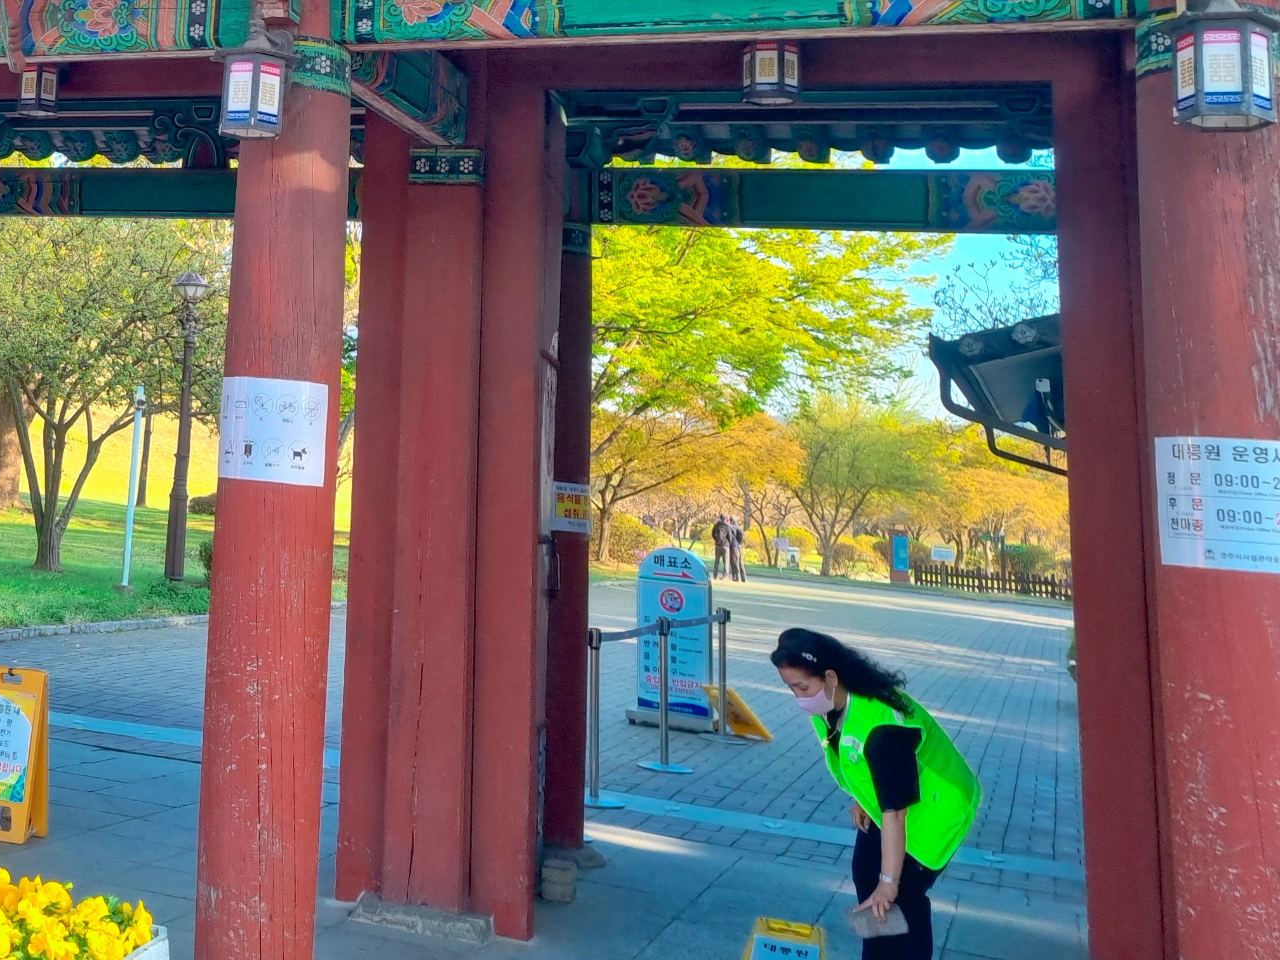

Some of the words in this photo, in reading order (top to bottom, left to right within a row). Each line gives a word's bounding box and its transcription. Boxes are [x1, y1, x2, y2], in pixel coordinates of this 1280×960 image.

[1172, 444, 1221, 461] 대릉원
[1171, 518, 1203, 531] 천마총
[654, 554, 692, 569] 매표소
